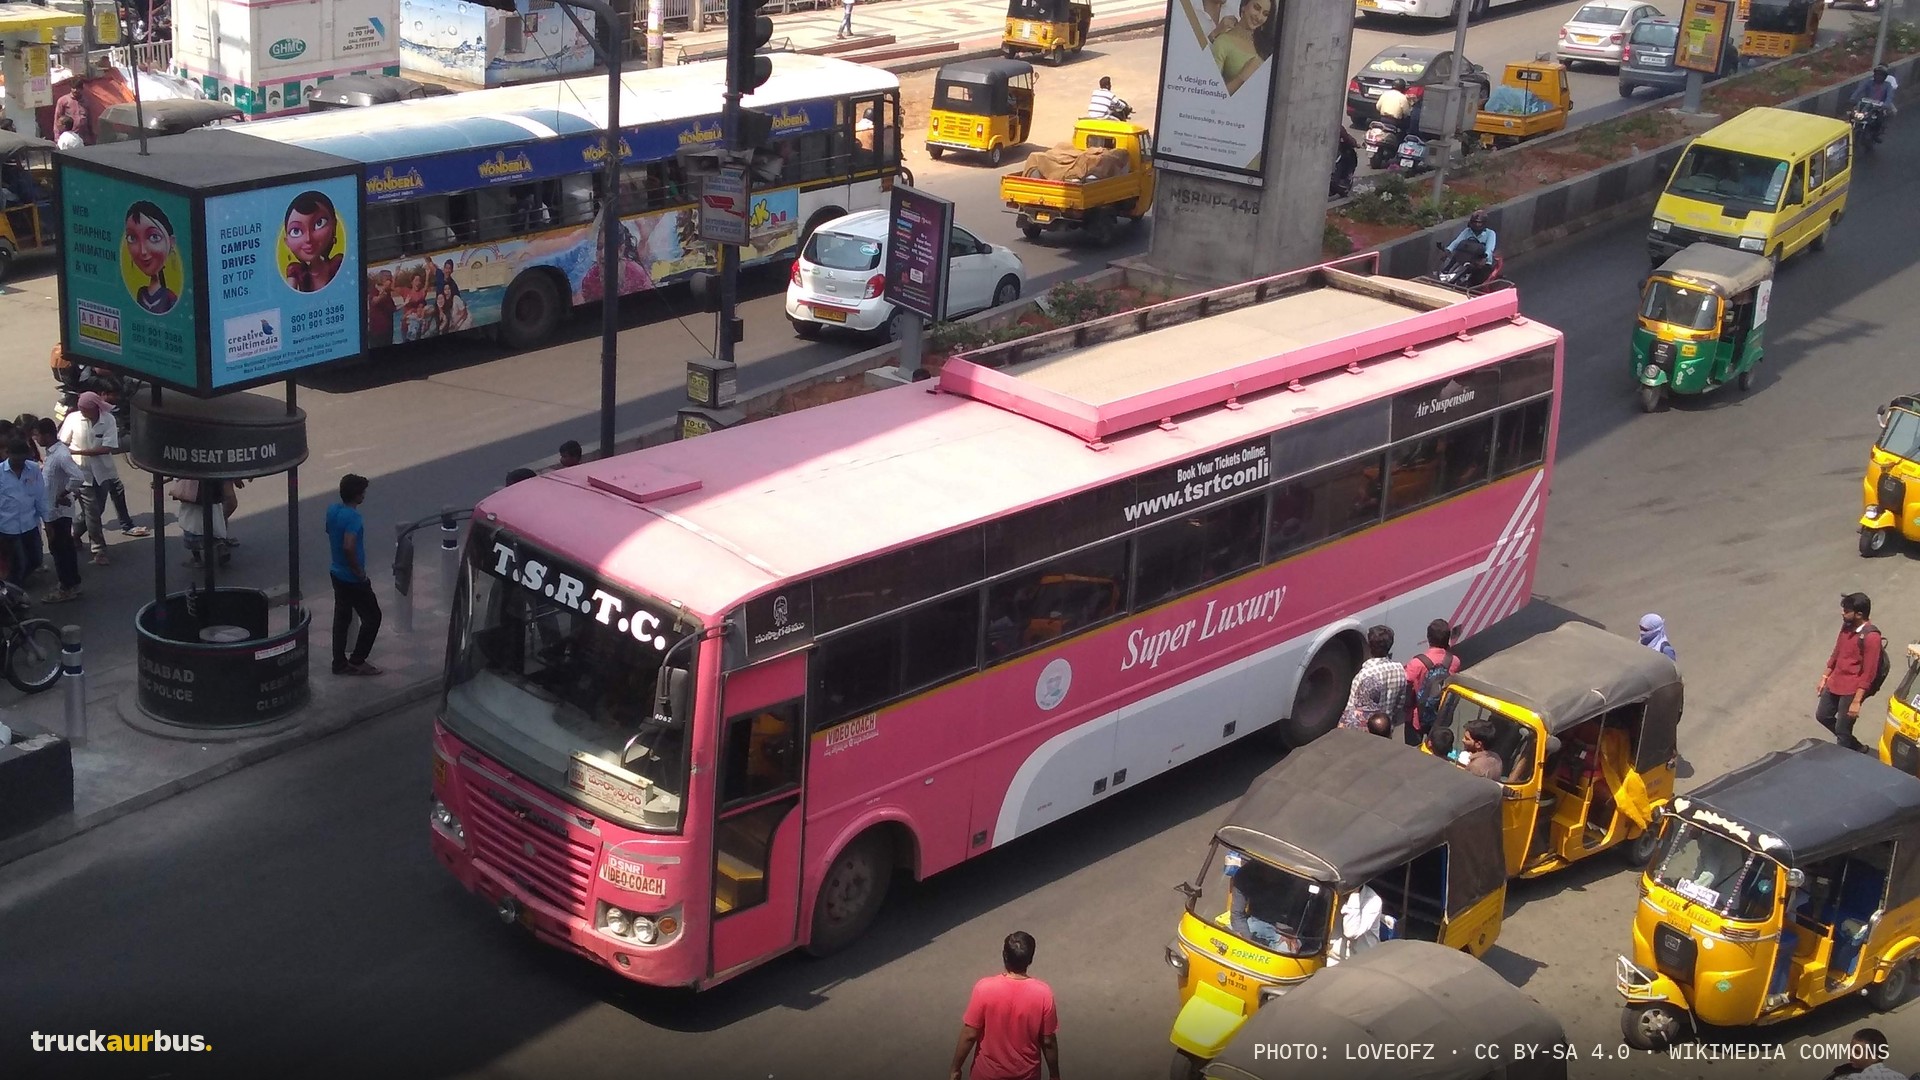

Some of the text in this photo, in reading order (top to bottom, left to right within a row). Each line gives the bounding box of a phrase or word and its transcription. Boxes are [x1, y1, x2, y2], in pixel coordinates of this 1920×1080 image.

[272, 41, 304, 55] GHMC
[1184, 75, 1206, 86] design
[1208, 78, 1220, 87] for
[1167, 84, 1228, 99] every relationship
[479, 160, 532, 179] WONDERLA
[366, 174, 425, 194] WONDERLA
[72, 204, 89, 218] WEB
[73, 223, 112, 242] GRAPHICS
[220, 222, 262, 240] REGULAR
[74, 243, 117, 261] ANIMATION
[221, 238, 261, 255] CAMPUS
[83, 263, 98, 275] VFX
[221, 254, 256, 270] DRIVES
[222, 269, 254, 285] BY TOP
[81, 311, 119, 331] ARENA
[291, 313, 345, 333] 801 901 3399
[308, 309, 323, 320] 800
[228, 329, 264, 345] creative
[228, 335, 279, 353] multimedia
[1414, 388, 1475, 419] Air Suspension
[163, 443, 276, 464] AND SEAT BELT ON
[1177, 445, 1266, 483] Book Your Tickets Online:
[1123, 457, 1272, 522] www.tsrtconli
[493, 542, 666, 651] T.S.R.T.C.
[1120, 585, 1287, 672] Super Luxury
[152, 680, 194, 703] POLICE
[828, 722, 850, 745] VIDEO
[850, 713, 876, 736] COACH
[610, 857, 640, 874] DSNR
[1660, 896, 1681, 910] FOR
[1687, 908, 1713, 926] HIRE
